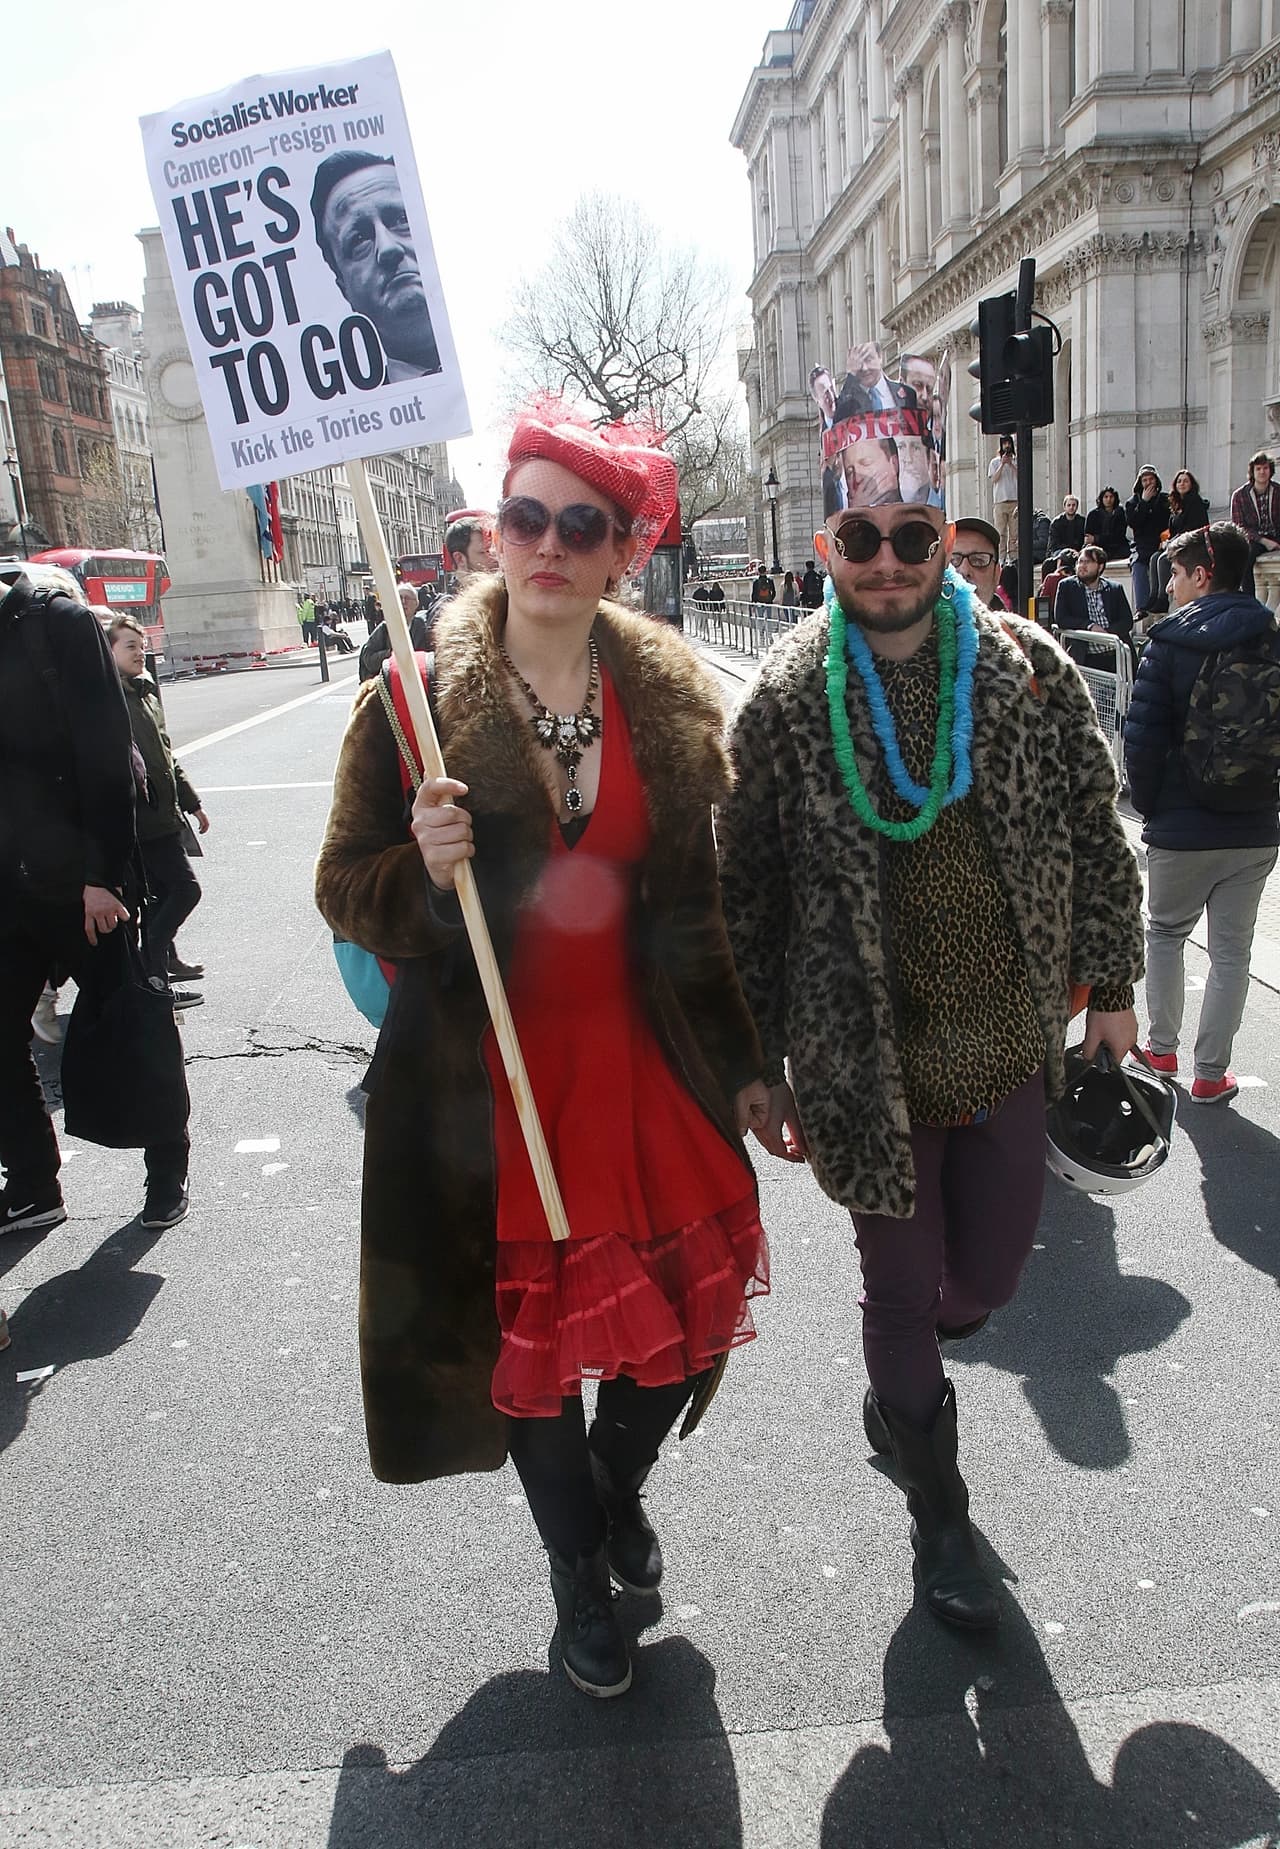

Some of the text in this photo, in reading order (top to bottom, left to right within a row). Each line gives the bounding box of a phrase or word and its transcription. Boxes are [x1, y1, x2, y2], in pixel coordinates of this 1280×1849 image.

[343, 114, 385, 142] now
[172, 166, 300, 270] HE'S
[193, 248, 301, 348] GOT
[209, 315, 384, 425] TO GO
[231, 396, 426, 468] Kick the Tories out
